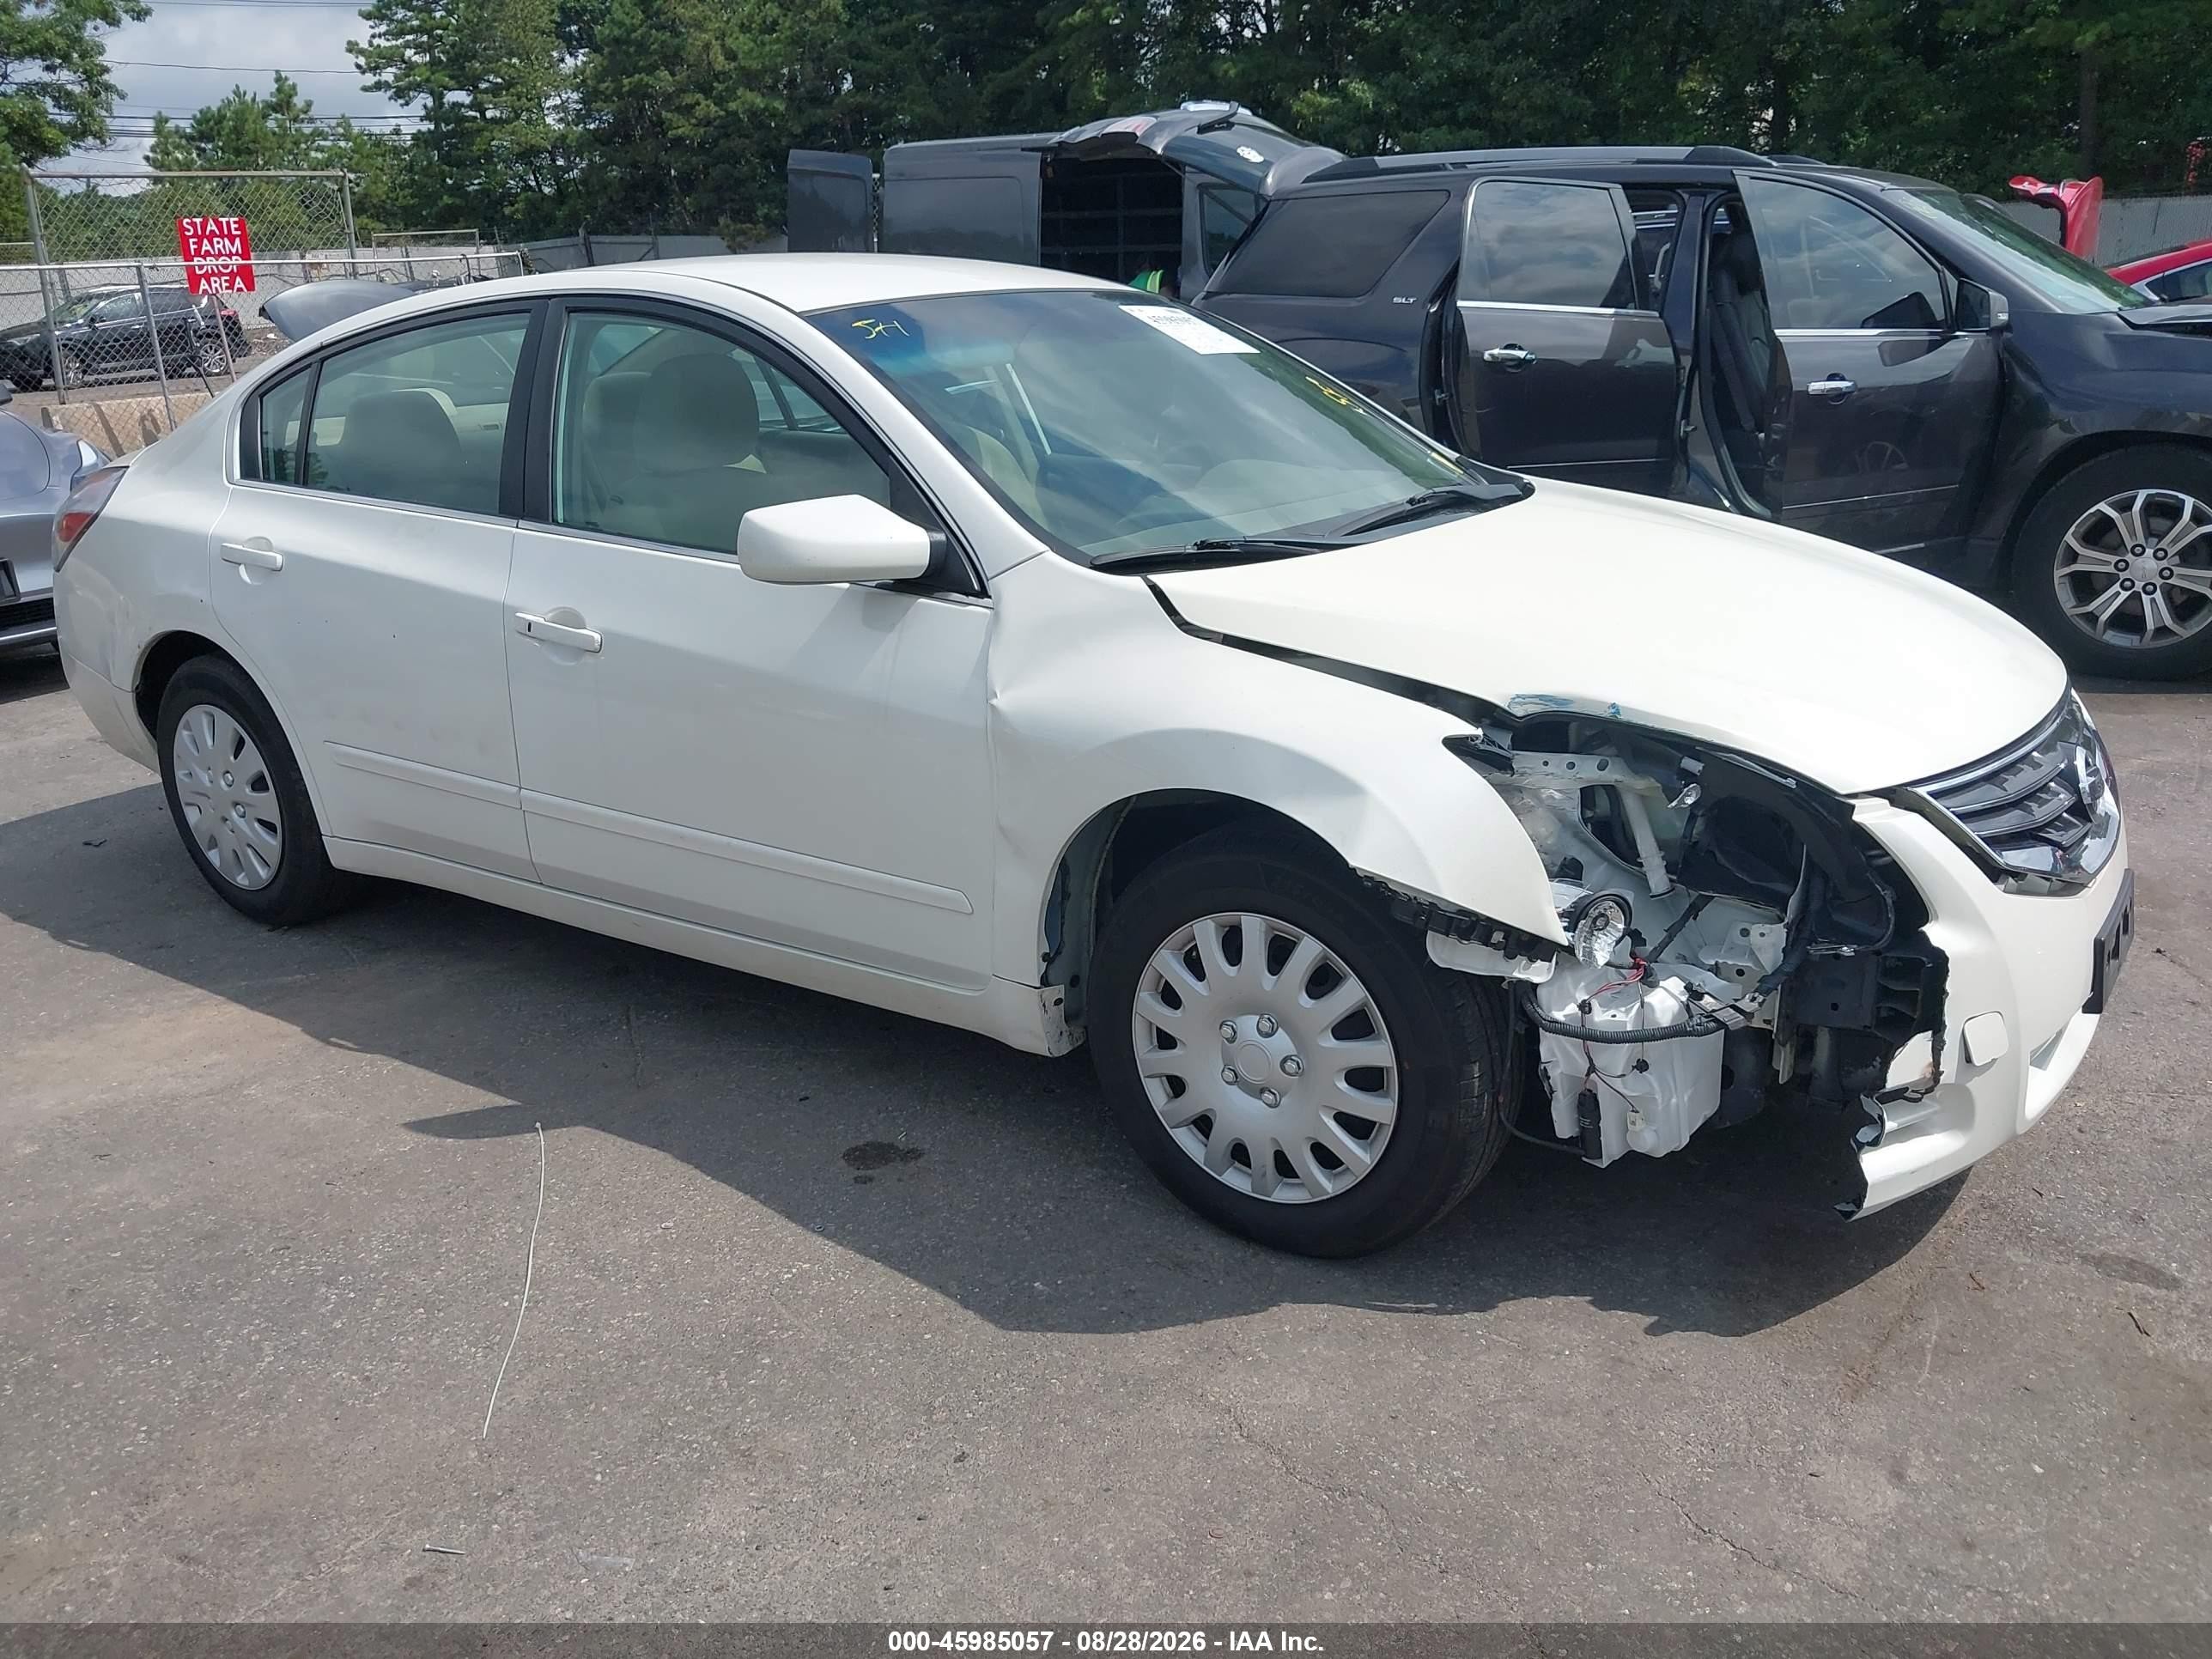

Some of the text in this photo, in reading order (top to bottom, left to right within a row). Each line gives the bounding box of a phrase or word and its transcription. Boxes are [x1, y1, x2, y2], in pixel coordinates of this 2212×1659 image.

[182, 217, 241, 235] STATE
[188, 237, 242, 255] FARM
[193, 256, 242, 274] DROP
[198, 276, 248, 295] AREA
